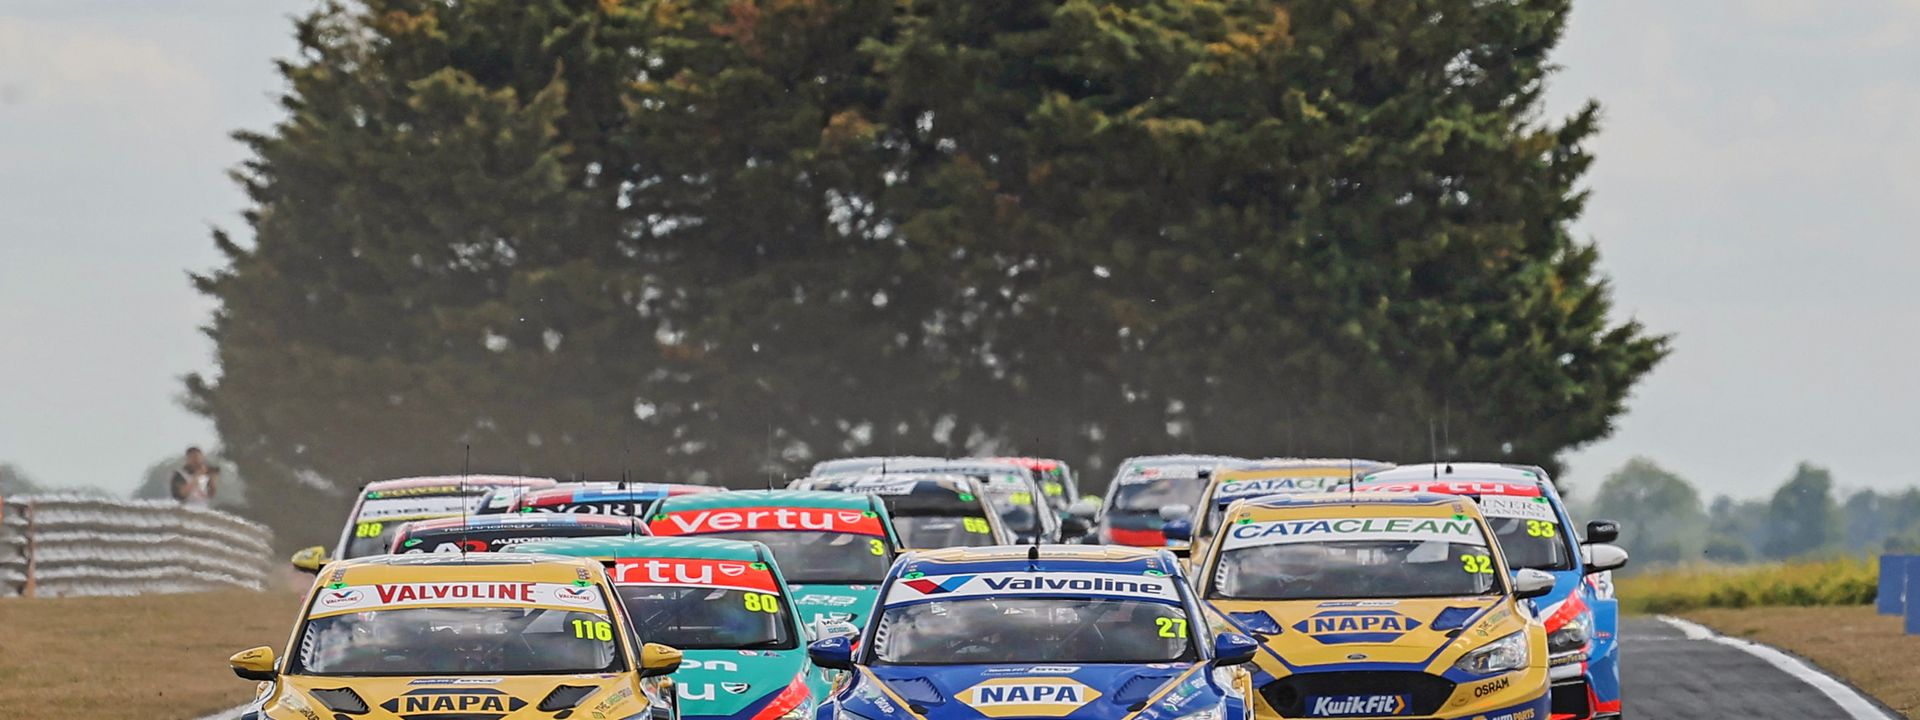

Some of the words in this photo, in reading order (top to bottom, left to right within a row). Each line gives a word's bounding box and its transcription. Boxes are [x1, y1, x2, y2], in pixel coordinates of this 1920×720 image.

[1221, 477, 1326, 493] CATACL
[669, 509, 834, 534] vertu
[1233, 518, 1474, 540] CATACLEAN
[1526, 520, 1556, 538] 33
[869, 539, 885, 556] 3
[613, 560, 714, 584] rtu
[1460, 554, 1495, 575] 32
[376, 582, 537, 604] VALVOLINE
[983, 576, 1163, 595] Valvoline
[743, 592, 779, 613] 80
[572, 619, 613, 642] 116
[1155, 616, 1188, 639] 27
[1315, 616, 1402, 633] NAPA
[980, 685, 1079, 704] NAPA
[1474, 677, 1511, 698] OSRAM
[405, 695, 505, 712] NAPA
